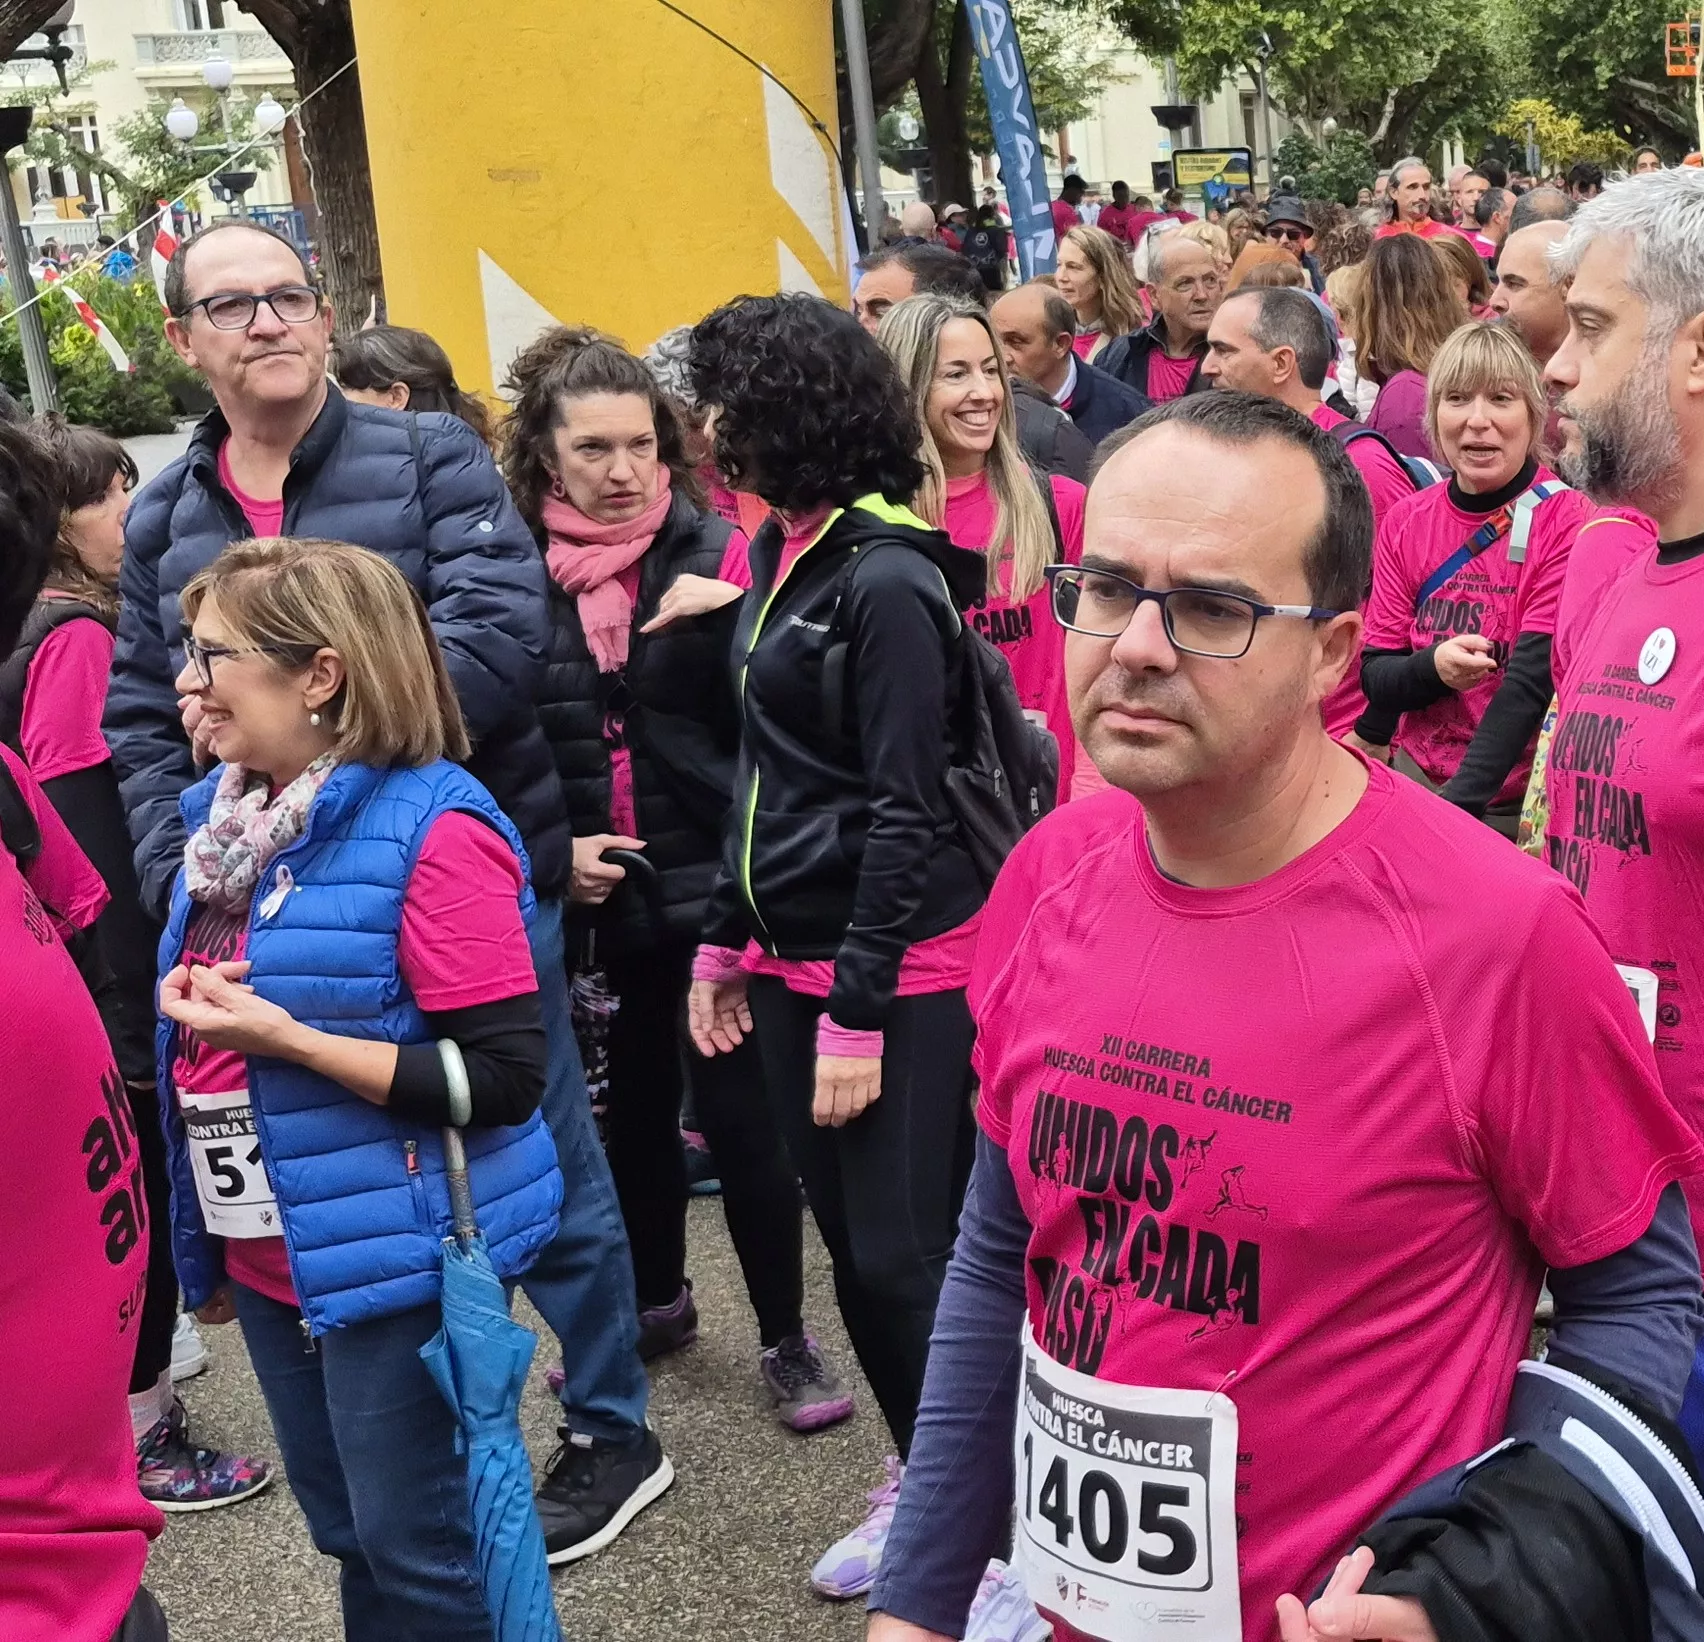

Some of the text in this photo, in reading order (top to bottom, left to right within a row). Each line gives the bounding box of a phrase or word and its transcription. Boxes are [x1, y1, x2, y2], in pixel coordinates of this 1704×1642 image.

[1636, 686, 1677, 711] CÁNCER
[1100, 1034, 1212, 1079] XII CARRERA
[1044, 1046, 1292, 1124] HUESCA CONTRA EL CÁNCER
[188, 1120, 258, 1139] CONTRA E
[225, 1108, 254, 1120] HUE
[205, 1141, 263, 1197] 5
[1028, 1090, 1181, 1212] UNIDOS
[1077, 1196, 1261, 1325] EN CADA
[1052, 1391, 1107, 1428] HUESCA
[1066, 1421, 1089, 1449] EL
[1092, 1429, 1194, 1469] CÁNCER
[1024, 1430, 1197, 1577] 1405
